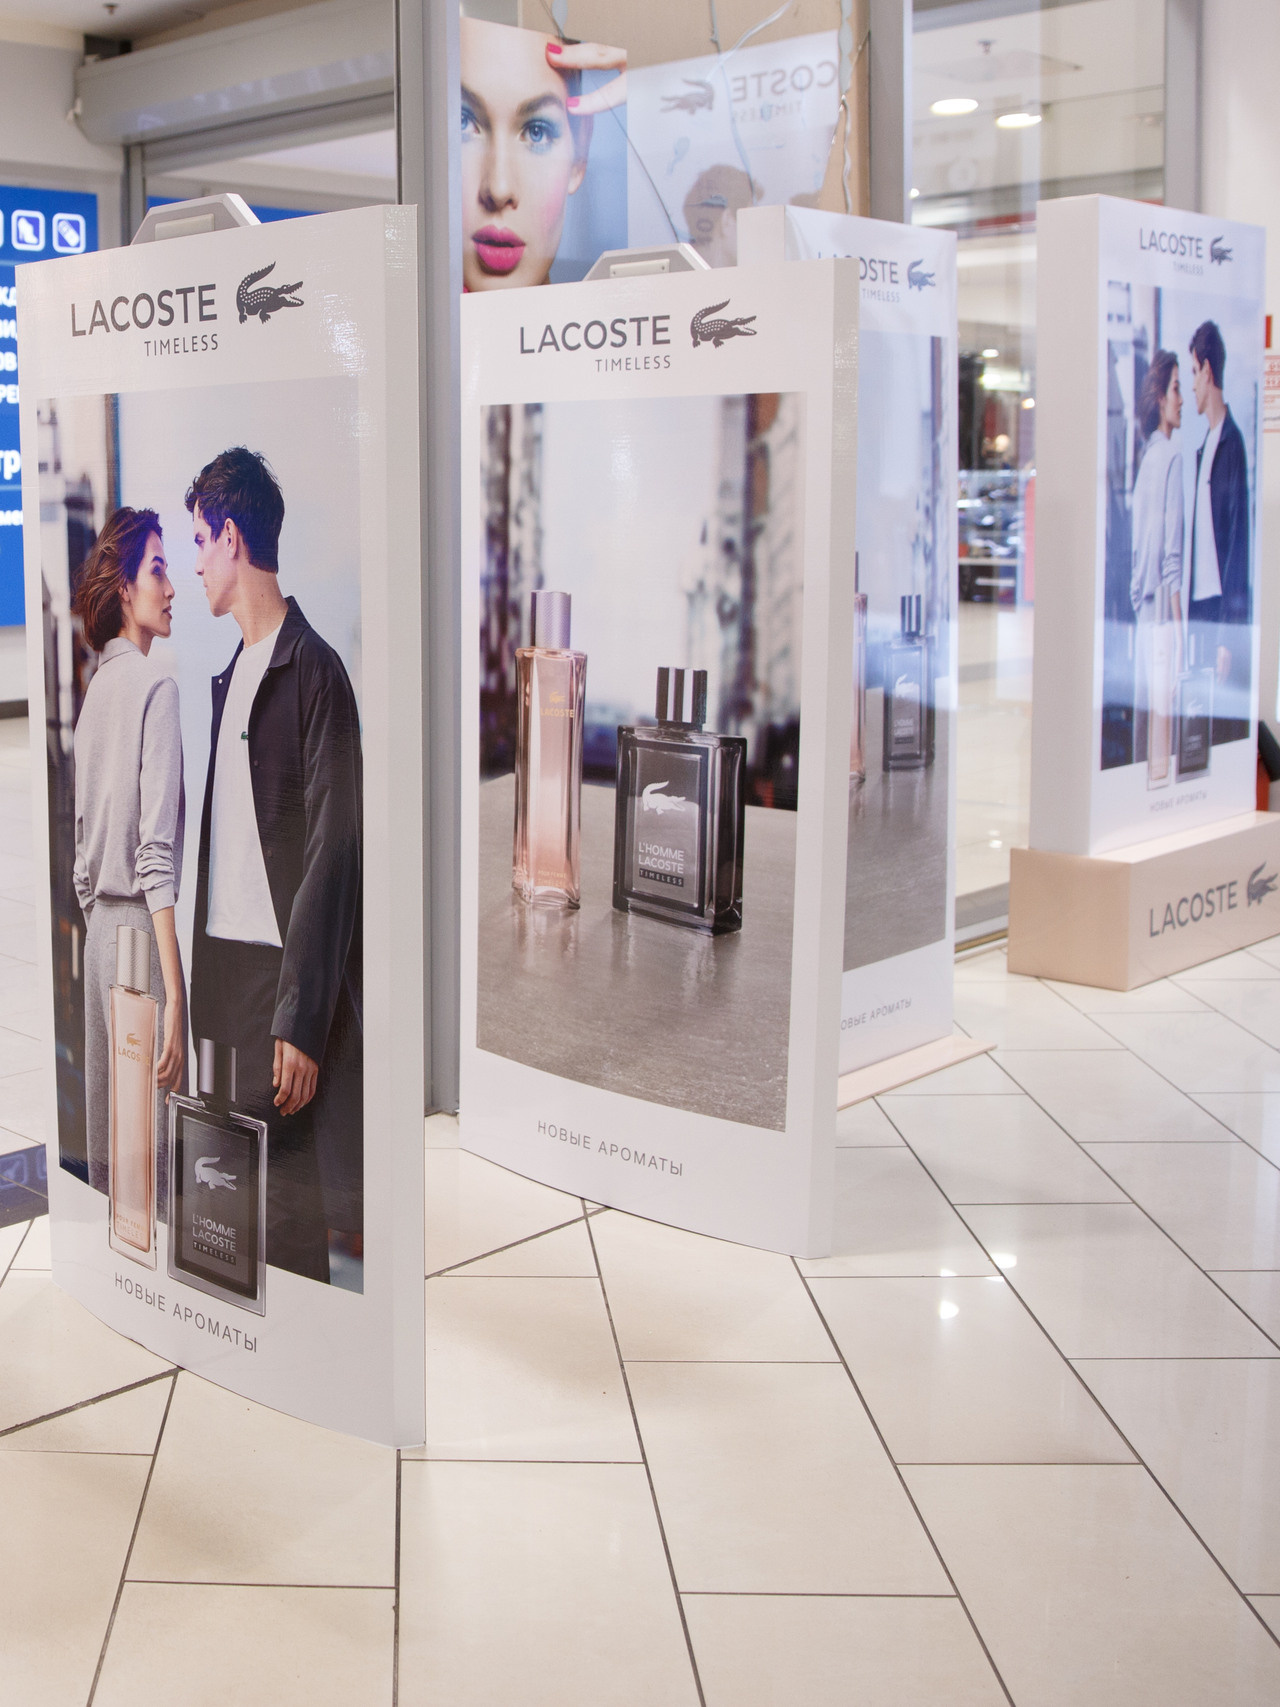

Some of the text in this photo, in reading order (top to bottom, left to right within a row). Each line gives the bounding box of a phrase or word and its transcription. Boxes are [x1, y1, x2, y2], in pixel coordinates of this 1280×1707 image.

[1140, 228, 1203, 259] LACOSTE
[862, 288, 900, 303] TIMELESS
[71, 283, 218, 337] LACOSTE
[144, 333, 218, 356] TIMELESS
[520, 314, 671, 355] LACOSTE
[595, 356, 671, 372] TIMELESS
[638, 842, 685, 862] L'HOMME
[638, 855, 684, 874] LACOSTE
[640, 869, 682, 886] TIMELESS
[1150, 880, 1238, 938] LACOSTE
[870, 996, 912, 1021] АРОМАТЫ
[117, 1046, 151, 1066] LACOSE
[537, 1120, 683, 1177] НОВЫЕ АРОМАТЫ
[192, 1213, 237, 1240] L'HOMME
[192, 1226, 236, 1252] LACOSTE
[193, 1241, 235, 1263] TIMELESS
[114, 1271, 258, 1354] НОВЫЕ АРОМАТЫ
